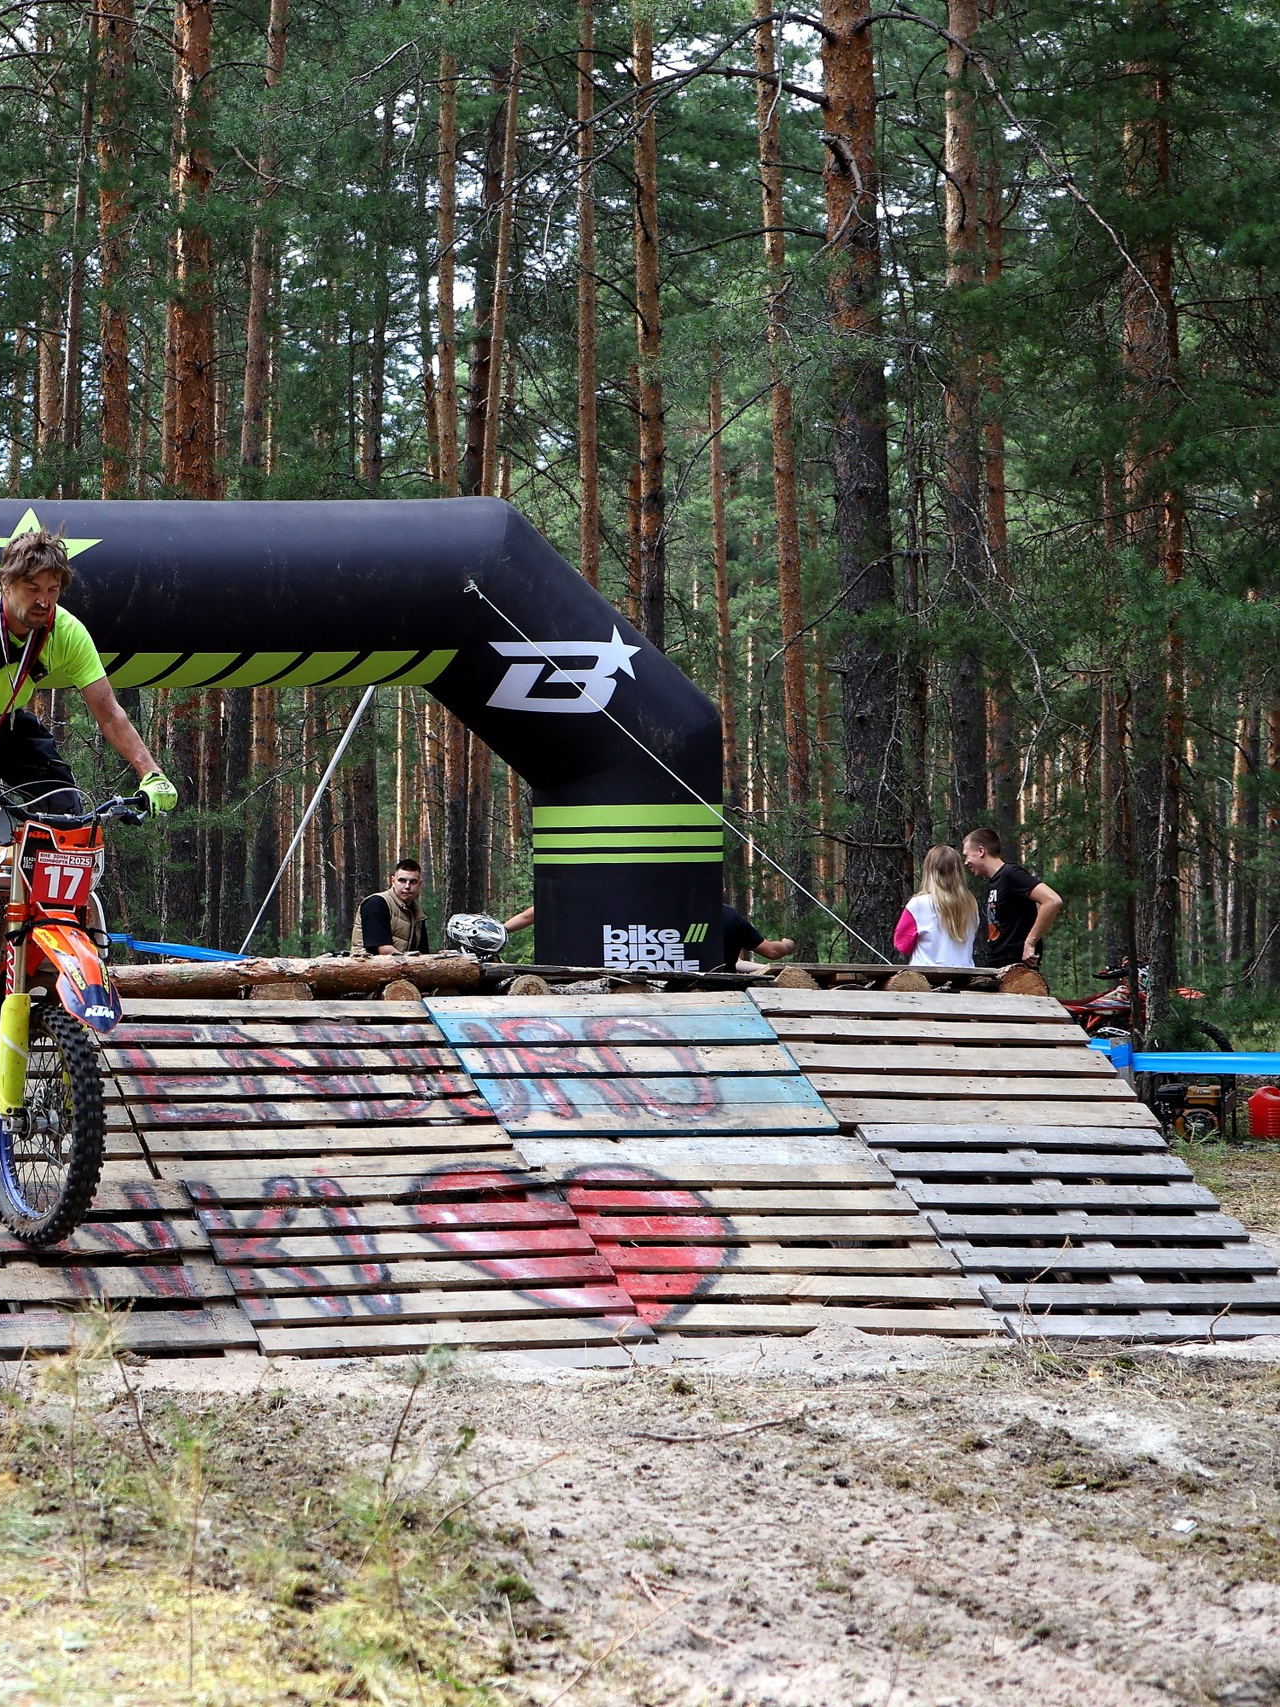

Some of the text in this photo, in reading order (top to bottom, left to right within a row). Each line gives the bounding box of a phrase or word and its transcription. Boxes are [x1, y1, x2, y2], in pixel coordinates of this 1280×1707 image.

[28, 831, 50, 839] KTM
[70, 856, 91, 866] 2025
[44, 865, 84, 900] 17
[603, 924, 681, 944] bike
[603, 943, 685, 961] RIDE
[84, 1005, 115, 1020] KTM
[107, 1019, 722, 1124] ENDURO
